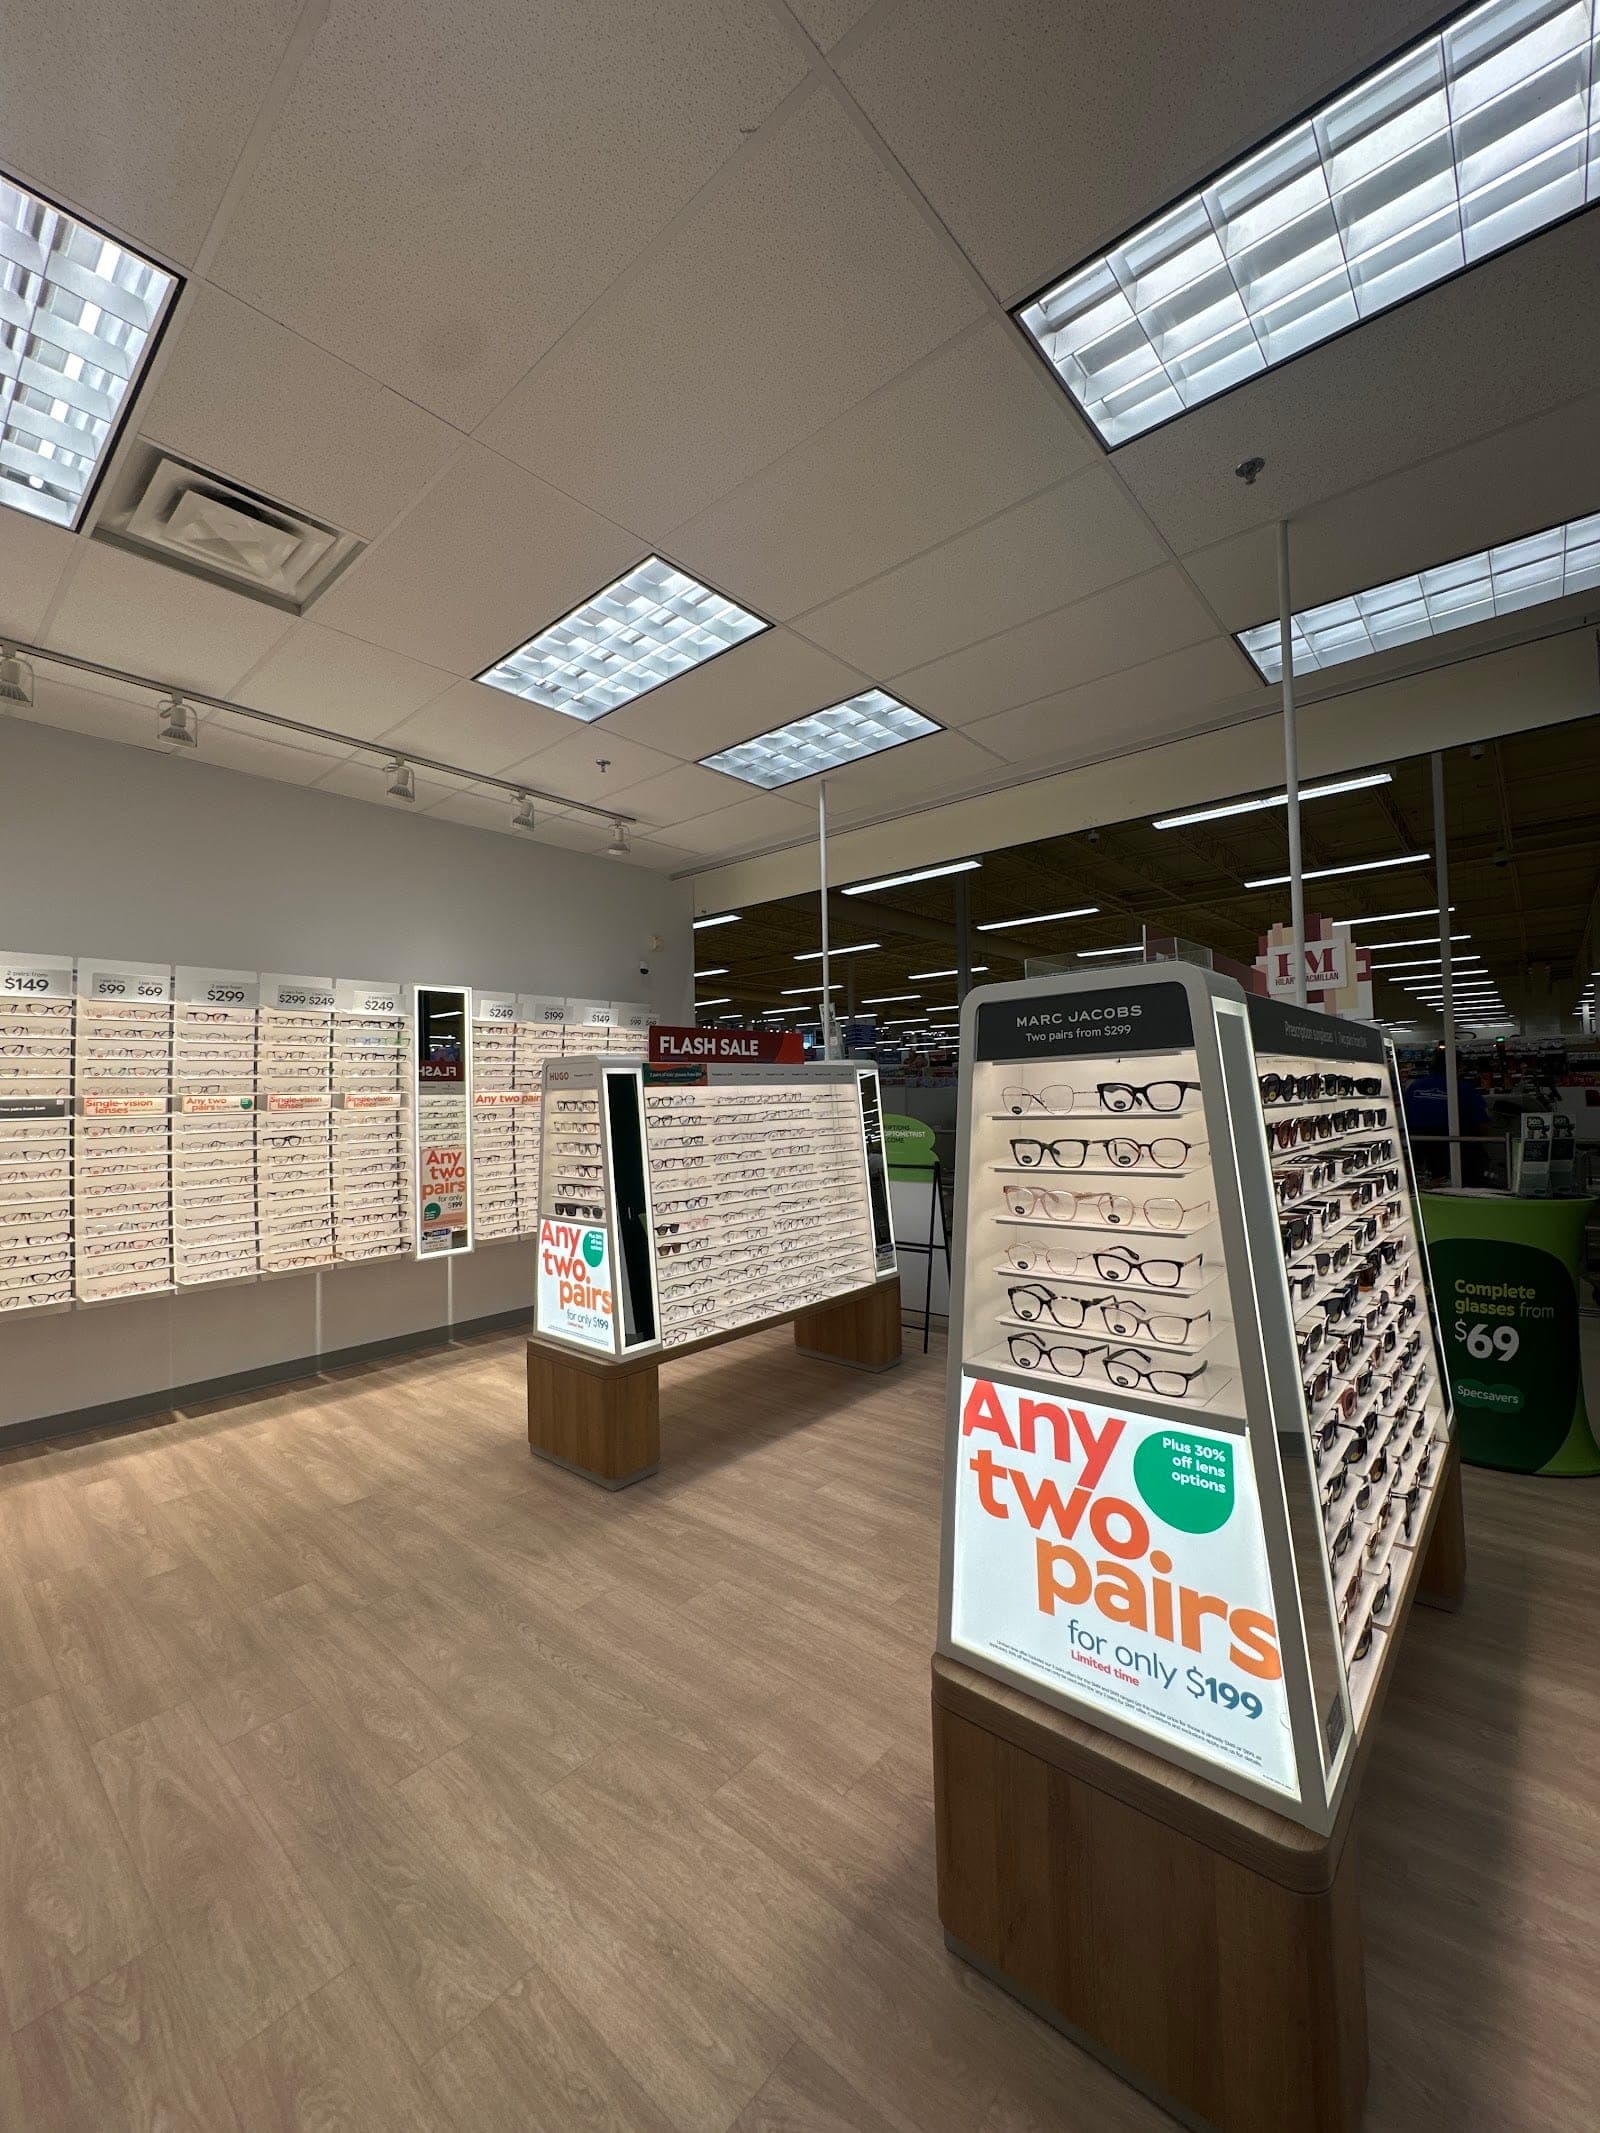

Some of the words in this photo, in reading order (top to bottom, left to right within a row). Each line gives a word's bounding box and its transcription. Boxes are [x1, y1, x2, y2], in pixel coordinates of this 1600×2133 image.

[4, 977, 50, 991] $149
[1275, 977, 1296, 986] HILAR
[1305, 972, 1339, 983] ACMILLAN
[98, 983, 126, 994] $99
[137, 986, 163, 996] $69
[207, 990, 245, 1002] $299
[279, 994, 306, 1004] $299
[308, 997, 335, 1006] $249
[364, 1000, 394, 1011] $249
[489, 1008, 513, 1018] $249
[544, 1011, 564, 1020] $199
[591, 1015, 610, 1023] $149
[1016, 1013, 1063, 1028] MARC
[1068, 1005, 1143, 1023] JACOBS
[630, 1018, 641, 1026] $99
[1025, 1033, 1047, 1042] Two
[1049, 1030, 1073, 1042] pairs
[1076, 1027, 1102, 1038] from
[1104, 1024, 1132, 1037] $299
[659, 1036, 716, 1055] FLASH
[720, 1038, 759, 1056] SALE
[549, 1072, 569, 1081] HUGO
[86, 1099, 153, 1107] Single-vision
[186, 1097, 206, 1106] Any
[208, 1097, 227, 1105] two
[476, 1094, 497, 1104] Any
[500, 1095, 519, 1103] two
[522, 1093, 542, 1104] pair
[95, 1106, 129, 1114] lenses
[191, 1105, 215, 1113] pairs
[426, 1151, 462, 1167] Any
[430, 1166, 465, 1180] two
[422, 1178, 465, 1200] pairs
[447, 1201, 463, 1209] $199
[449, 1194, 463, 1202] only
[541, 1219, 581, 1257] Any
[543, 1248, 586, 1282] two
[559, 1276, 613, 1314] pairs
[1455, 1279, 1536, 1299] Complete
[1455, 1298, 1515, 1316] glasses
[1519, 1302, 1555, 1318] from
[567, 1309, 576, 1321] for
[577, 1313, 592, 1327] only
[592, 1316, 609, 1330] $199
[1454, 1319, 1519, 1361] $69
[1457, 1385, 1519, 1404] Specsavers
[962, 1379, 1127, 1490] Any
[1162, 1436, 1191, 1454] Plus
[1194, 1444, 1226, 1462] 30%
[1172, 1455, 1193, 1469] off
[1195, 1459, 1226, 1478] lens
[1171, 1471, 1226, 1494] options
[969, 1449, 1150, 1561] two
[1036, 1537, 1283, 1680] pairs
[1067, 1619, 1107, 1655] for
[1115, 1645, 1178, 1690] only
[1186, 1666, 1263, 1720] $199
[1070, 1649, 1112, 1675] Limited
[1113, 1667, 1140, 1687] time
